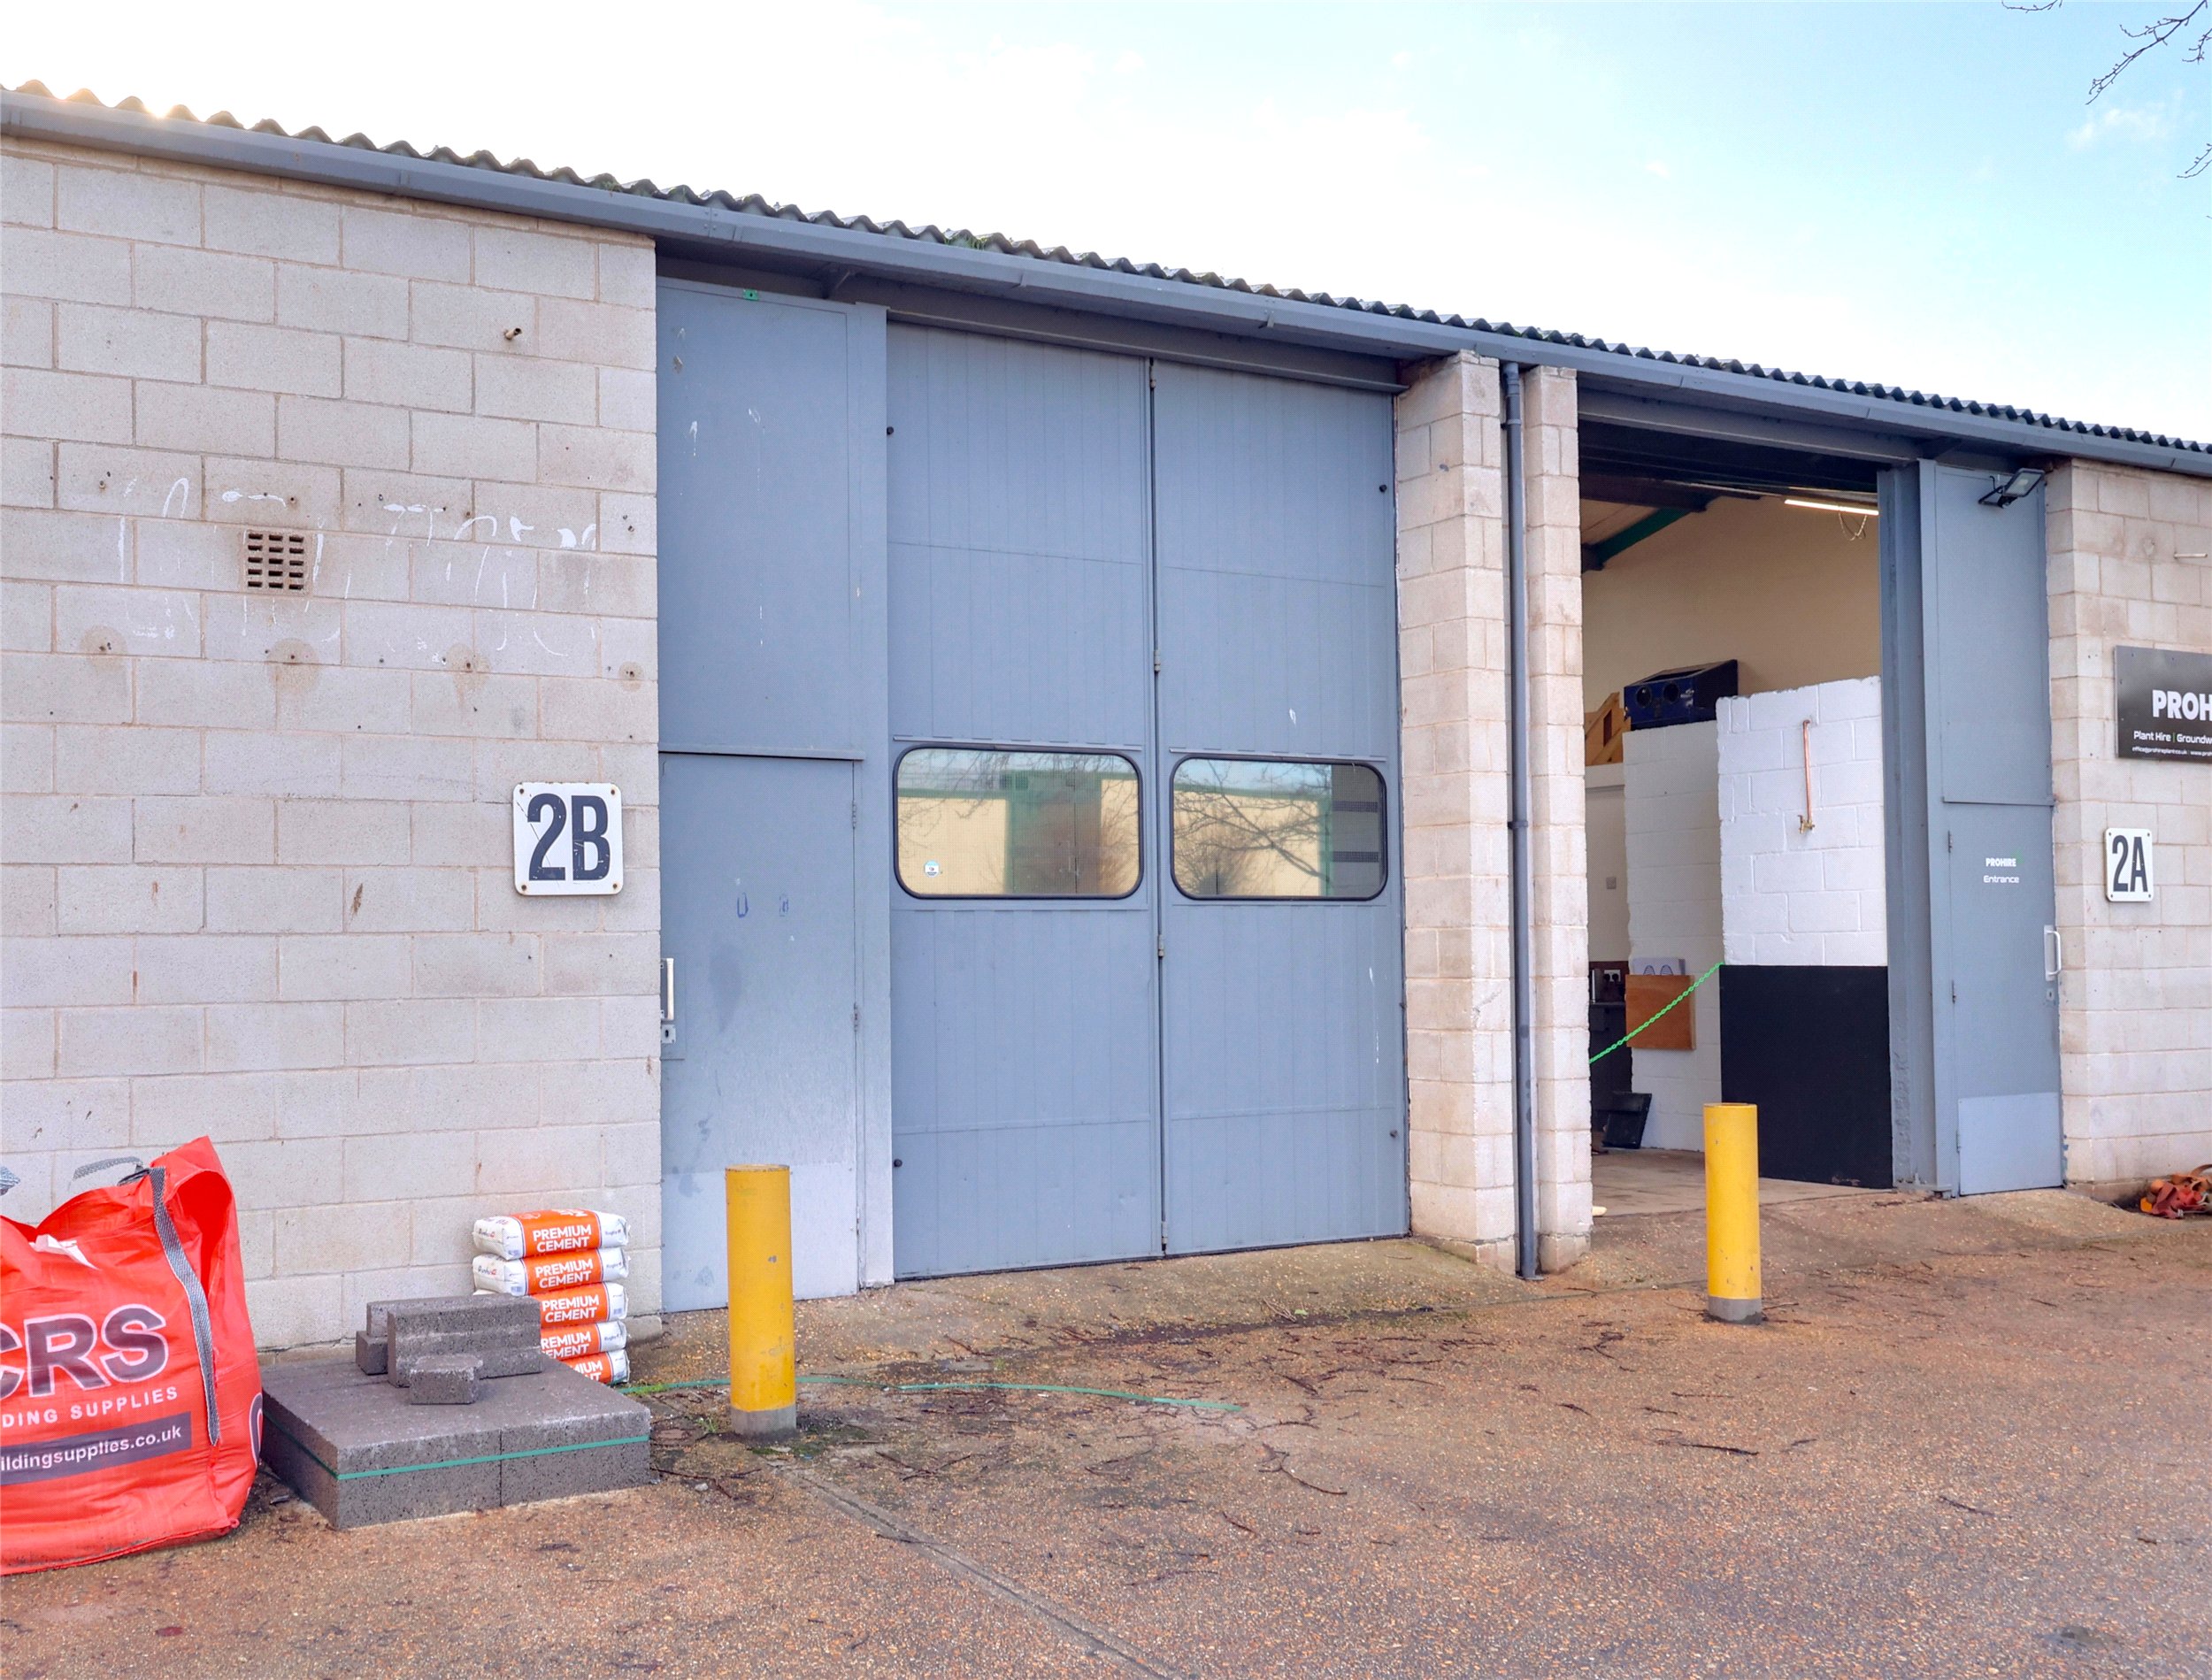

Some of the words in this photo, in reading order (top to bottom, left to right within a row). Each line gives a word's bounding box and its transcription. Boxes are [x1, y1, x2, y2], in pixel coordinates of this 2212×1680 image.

[2152, 689, 2212, 721] PROH
[2133, 731, 2154, 740] Plant
[2155, 732, 2171, 741] Hire
[527, 793, 611, 881] 2B
[1985, 857, 2016, 867] PROHIRE
[2111, 834, 2148, 893] 2A
[1983, 875, 2020, 884] Entrance
[533, 1224, 592, 1241] PREMIUM
[536, 1236, 590, 1253] CEMENT
[534, 1258, 594, 1277] PREMIUM
[539, 1270, 592, 1289] CEMENT
[541, 1294, 600, 1312] PREMIUM
[545, 1307, 597, 1323] CEMENT
[541, 1331, 592, 1349] REMIUM
[541, 1343, 590, 1358] EMENT
[572, 1361, 603, 1374] MIUM
[2, 1408, 58, 1427] DING
[70, 1386, 179, 1419] SUPPLIES
[0, 1425, 182, 1471] ildingsupplies.co.uk
